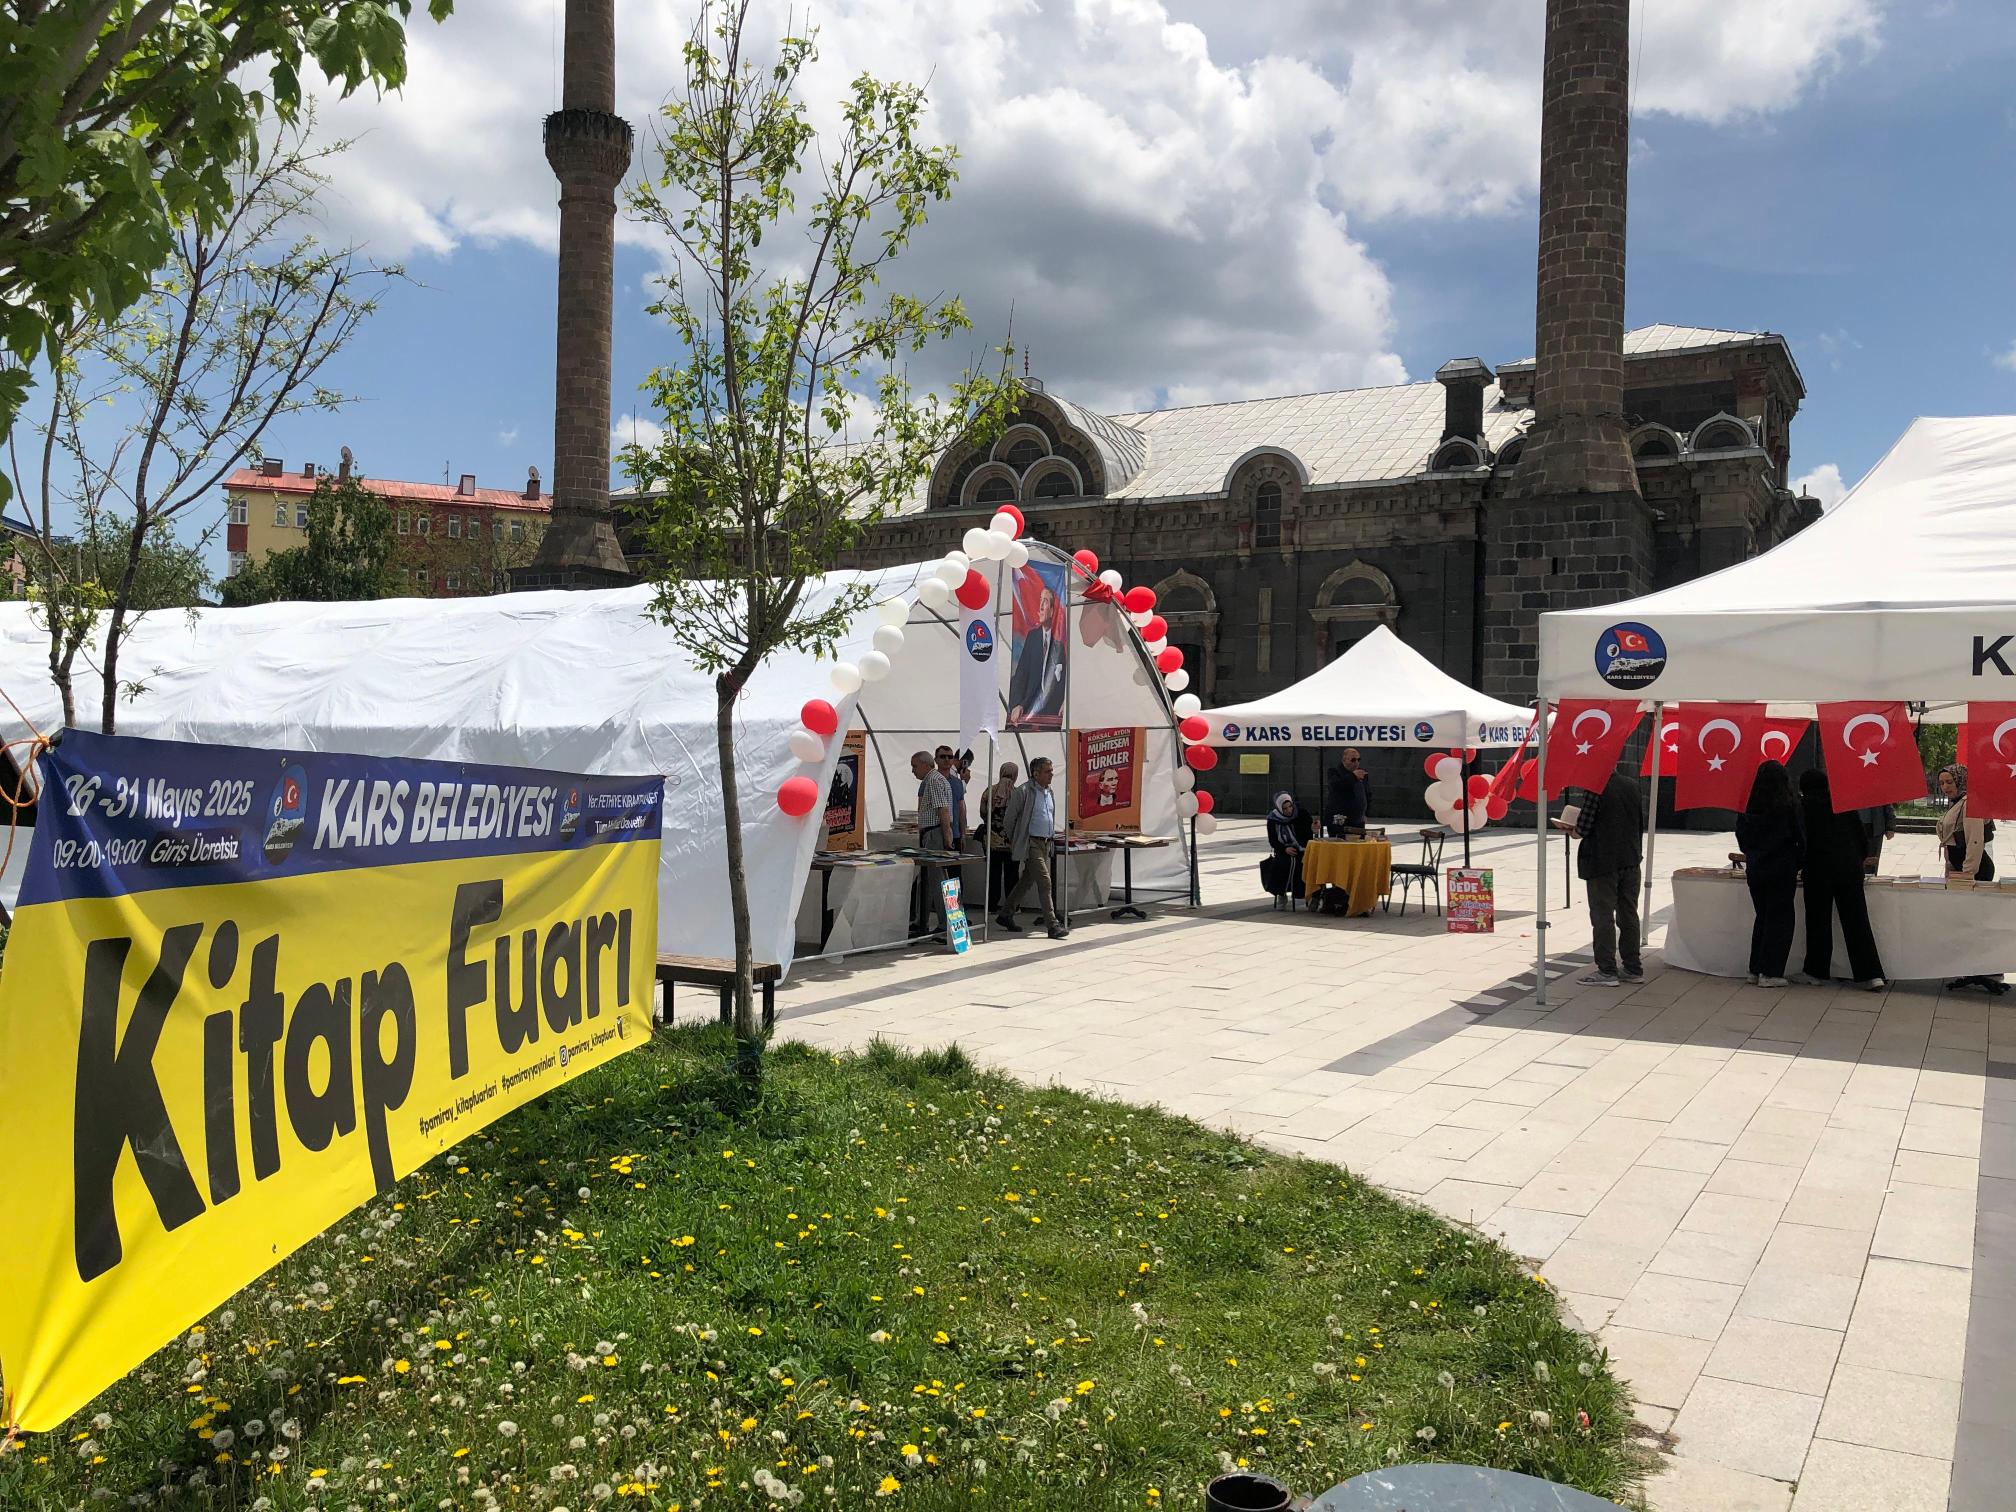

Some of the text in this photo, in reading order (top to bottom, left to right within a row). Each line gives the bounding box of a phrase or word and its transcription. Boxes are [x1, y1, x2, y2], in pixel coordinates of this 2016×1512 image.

[1245, 726, 1292, 741] KARS
[1489, 726, 1509, 742] KARS
[1087, 751, 1129, 771] TÜRKLER
[145, 777, 201, 828] Mayıs
[203, 779, 255, 817] 2025
[313, 779, 410, 850] KARS
[150, 837, 188, 867] Giriş
[189, 832, 240, 862] Ücretsiz
[1449, 880, 1479, 893] DEDE
[74, 878, 632, 1283] Kitap Fuarı
